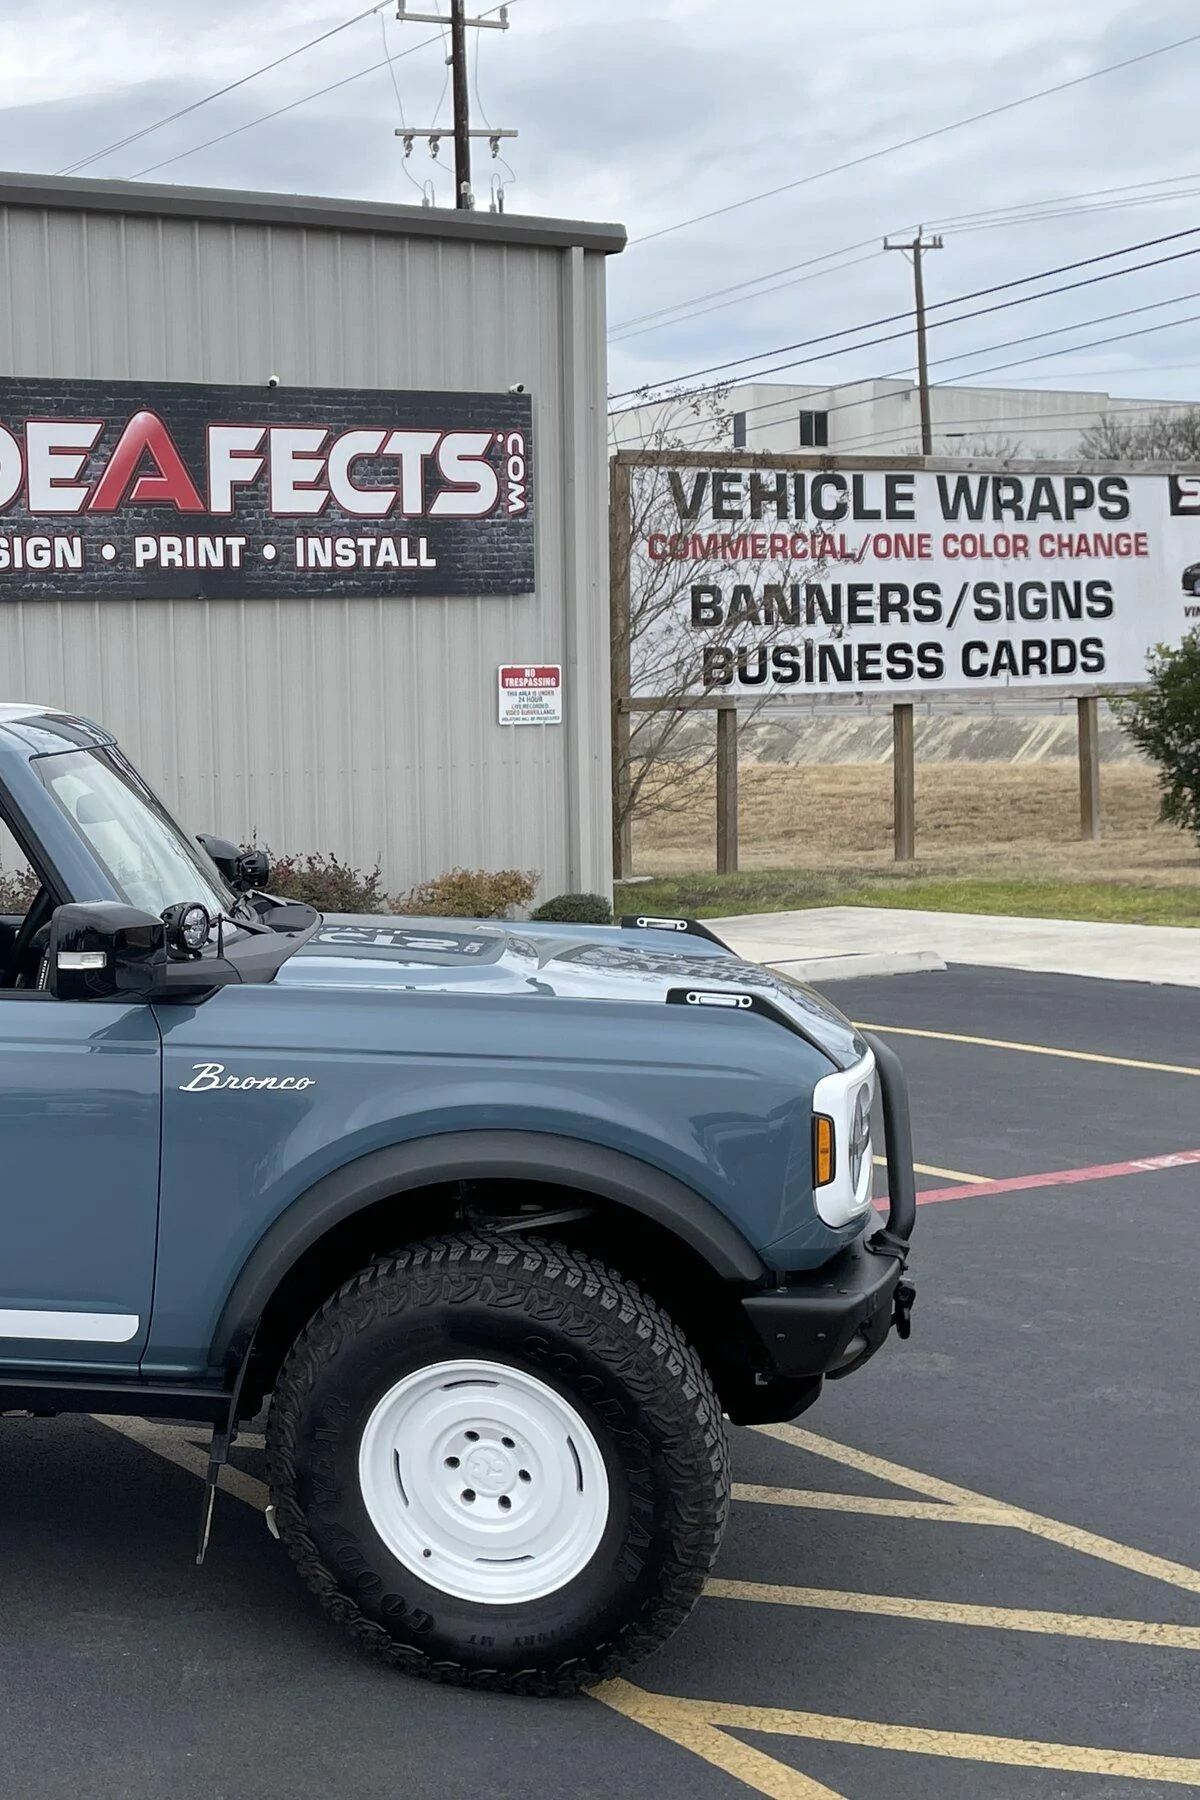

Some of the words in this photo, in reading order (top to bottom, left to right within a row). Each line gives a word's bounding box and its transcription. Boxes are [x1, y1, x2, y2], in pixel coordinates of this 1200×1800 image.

[668, 471, 917, 522] VEHICLE
[936, 474, 1130, 522] WRAPS
[133, 535, 248, 569] PRINT
[295, 536, 437, 569] INSTALL
[648, 533, 932, 563] COMMERCIAL/ONE
[943, 533, 1029, 559] COLOR
[1039, 532, 1149, 558] CHANGE
[690, 580, 1114, 629] BANNERS/SIGNS
[524, 668, 536, 677] NO
[702, 640, 944, 687] BUSINESS
[962, 637, 1105, 679] CARDS
[504, 678, 556, 687] TRESPASSING
[179, 1062, 315, 1092] Bronco
